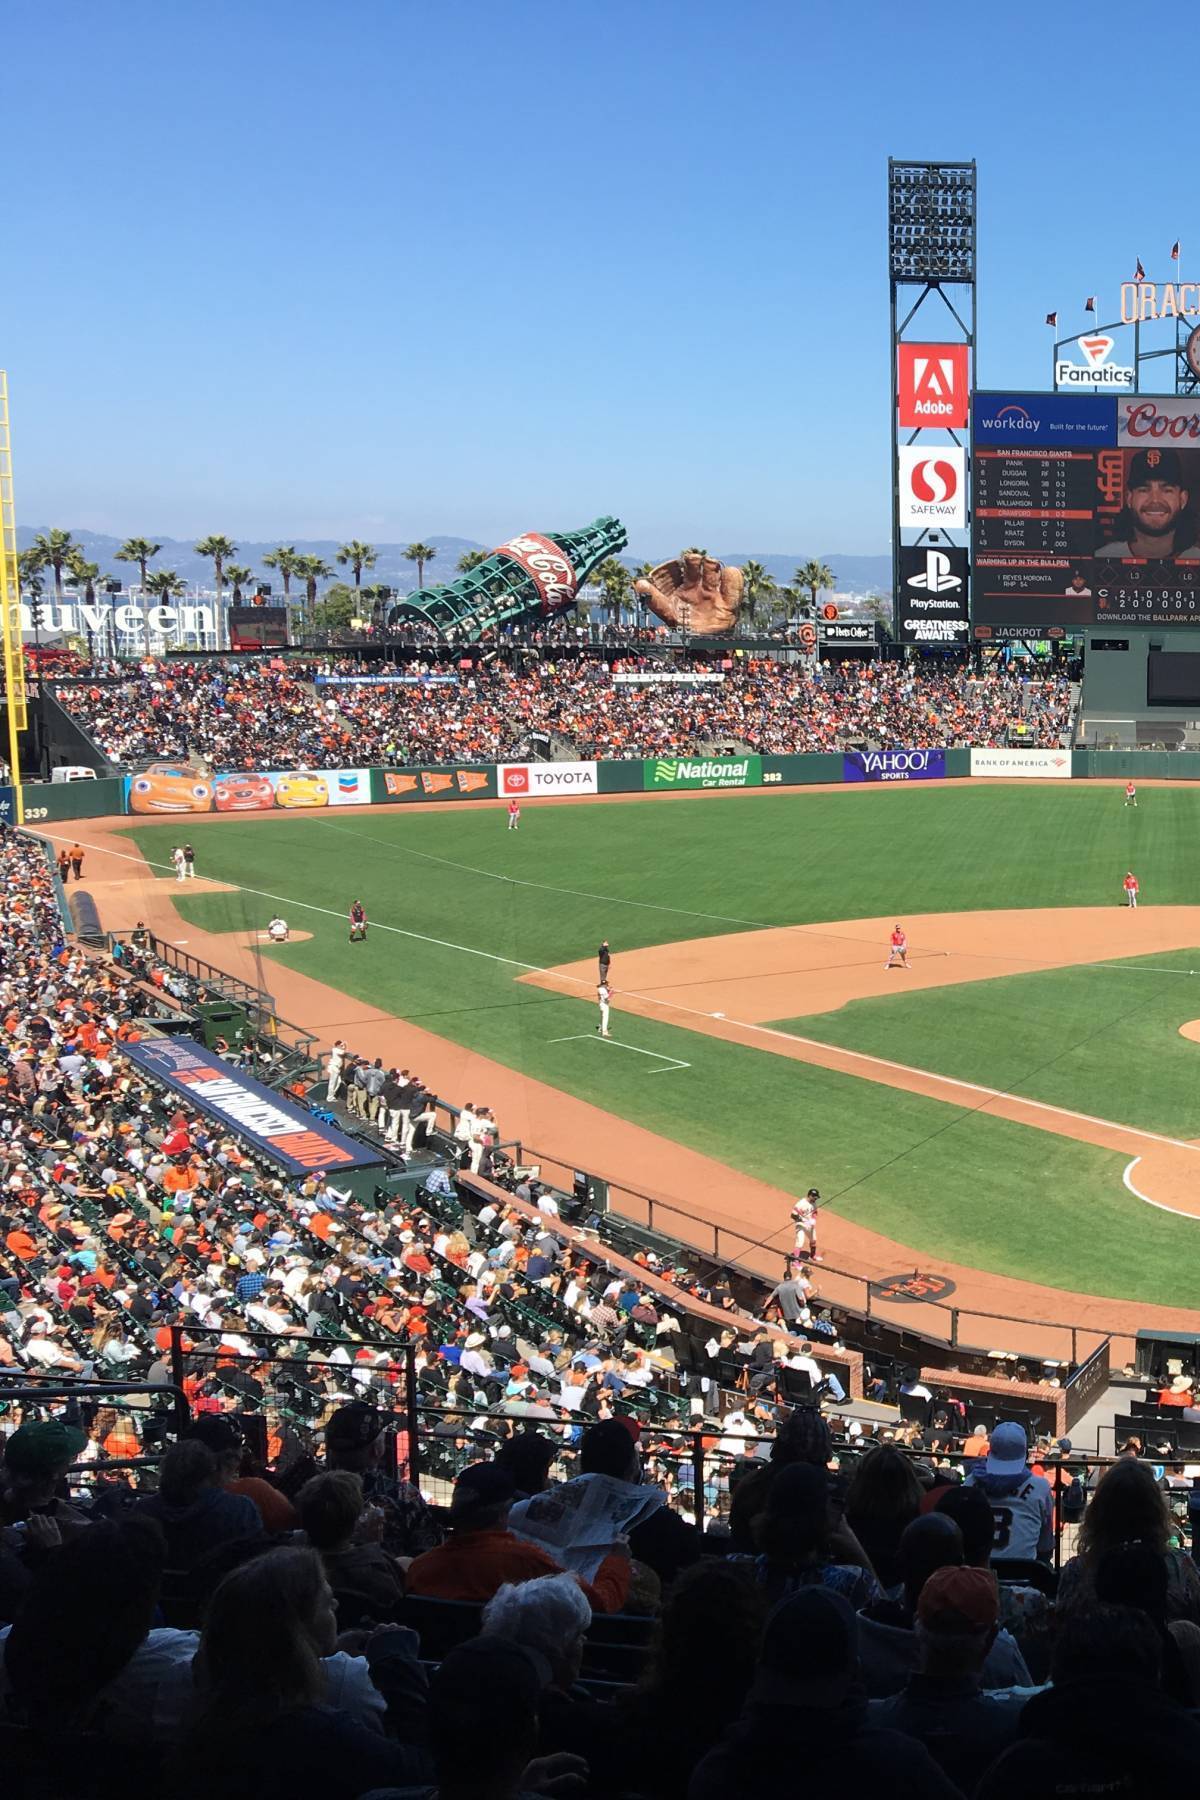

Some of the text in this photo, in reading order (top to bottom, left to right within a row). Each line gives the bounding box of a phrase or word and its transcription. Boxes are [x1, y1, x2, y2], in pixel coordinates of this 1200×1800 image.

[1060, 364, 1133, 382] Fanatics
[914, 400, 954, 414] Adobe
[982, 417, 1040, 432] workday
[1012, 450, 1048, 458] FRANCISCO
[911, 505, 956, 515] SAFEWAY
[910, 599, 958, 610] PlayStation
[904, 620, 966, 630] GREATNESS
[851, 627, 868, 638] Coffee
[914, 630, 955, 640] AWAITS
[996, 628, 1042, 637] JACKPOT
[861, 751, 929, 772] YAHOO!
[676, 760, 748, 779] National
[535, 773, 592, 785] TOYOTA
[763, 773, 782, 783] 382
[881, 772, 910, 780] SPORTS
[702, 778, 745, 787] Car Rental
[24, 808, 48, 819] 339
[206, 1092, 308, 1136] FRANCISCO
[267, 1131, 354, 1167] GIANTS
